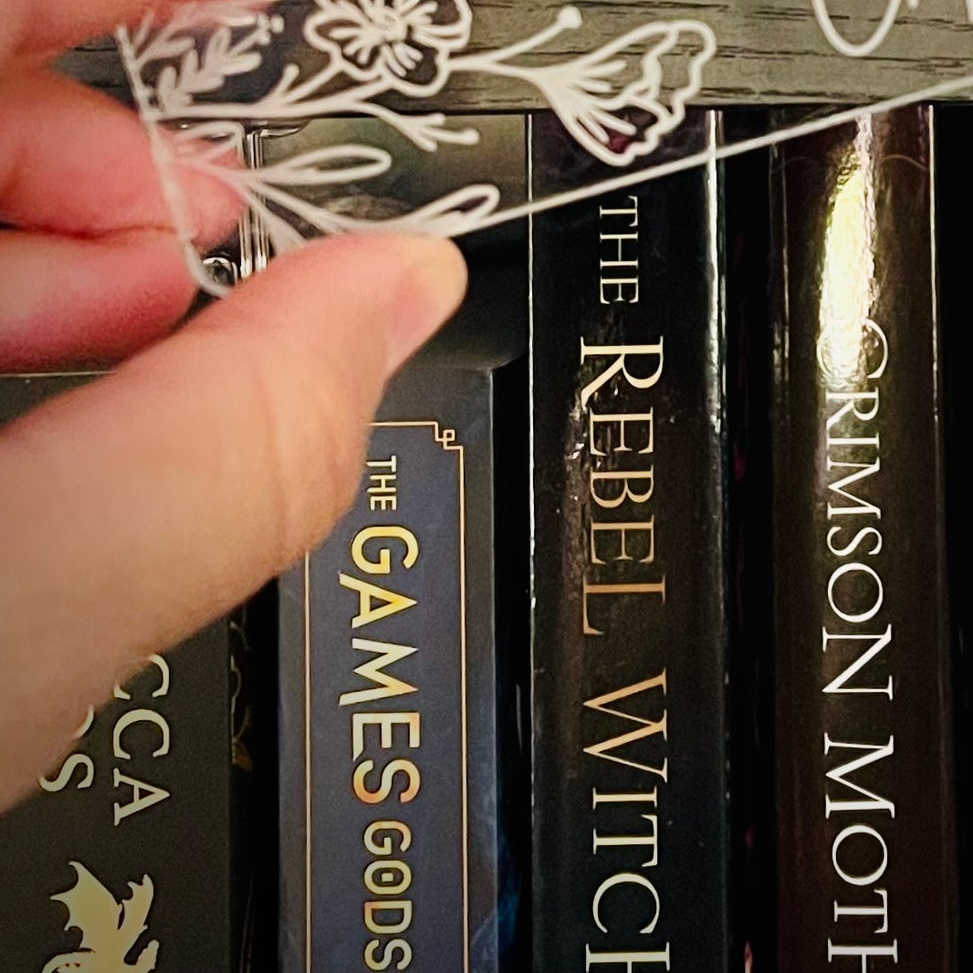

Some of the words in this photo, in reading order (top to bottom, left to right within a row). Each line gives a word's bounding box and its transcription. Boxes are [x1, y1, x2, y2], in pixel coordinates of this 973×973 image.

[599, 195, 639, 305] THE
[366, 455, 397, 511] THE
[580, 336, 666, 636] REBEL
[816, 317, 893, 700] CRIMSON
[338, 524, 422, 805] GAMES
[363, 819, 413, 971] GODS
